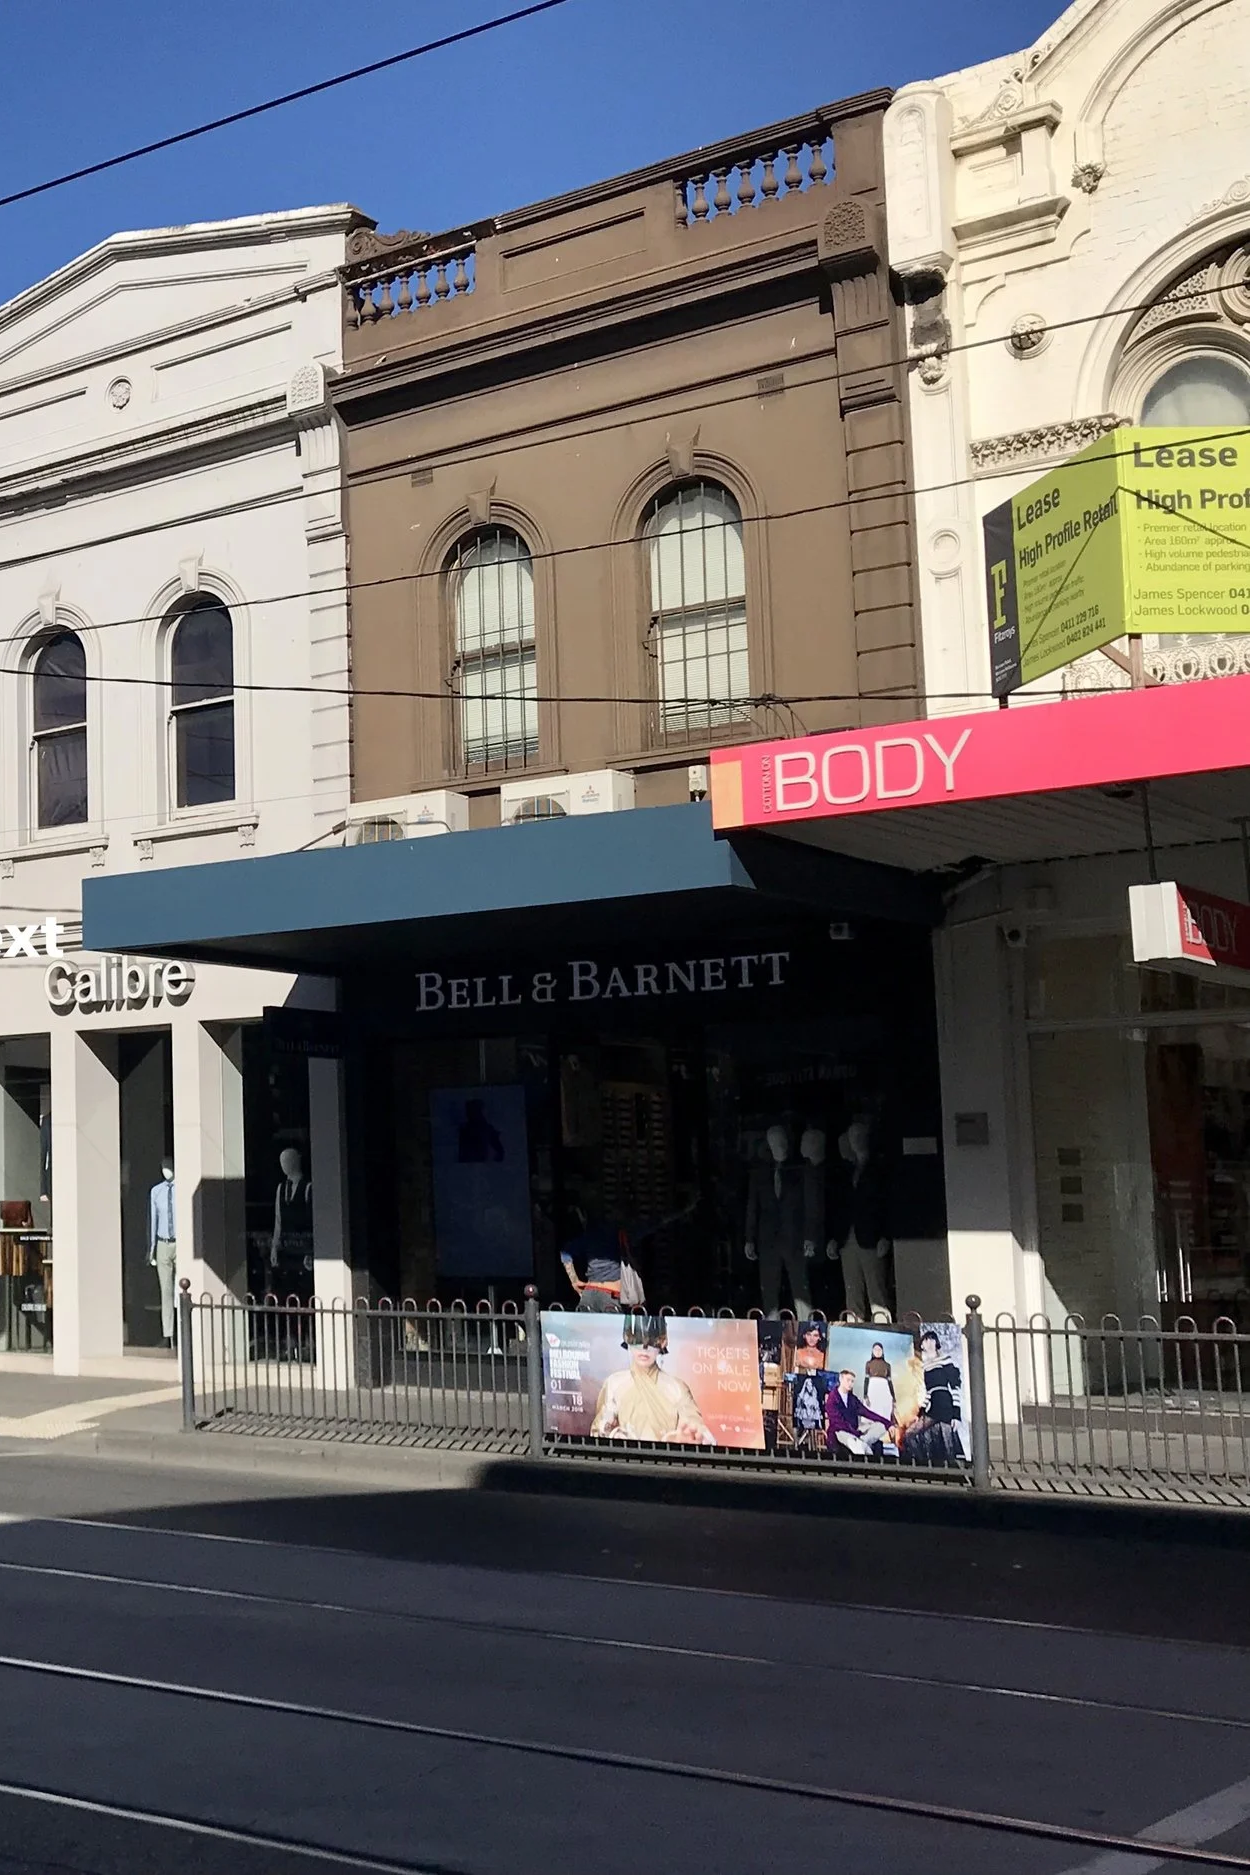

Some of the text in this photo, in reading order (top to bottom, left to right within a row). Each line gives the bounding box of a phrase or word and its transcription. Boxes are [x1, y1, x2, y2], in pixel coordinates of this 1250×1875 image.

[1134, 442, 1238, 468] Lease
[1017, 488, 1060, 531] Lease
[1135, 489, 1193, 515] High
[1019, 494, 1118, 570] High Profile Retail
[1143, 523, 1181, 533] Premier
[1144, 536, 1167, 546] Area
[1144, 549, 1167, 561] High
[1169, 548, 1204, 559] volume
[1145, 562, 1200, 572] Abundance
[1202, 562, 1212, 572] of
[1133, 588, 1174, 600] James
[1176, 588, 1226, 602] Spencer
[1134, 604, 1250, 616] James Lockwood 0
[774, 728, 973, 812] BODY
[44, 954, 195, 1010] Calibre
[415, 951, 791, 1012] BELL & BARNETT
[697, 1345, 750, 1360] TICKETS
[692, 1361, 751, 1377] ON SALE
[717, 1380, 752, 1393] NOW
